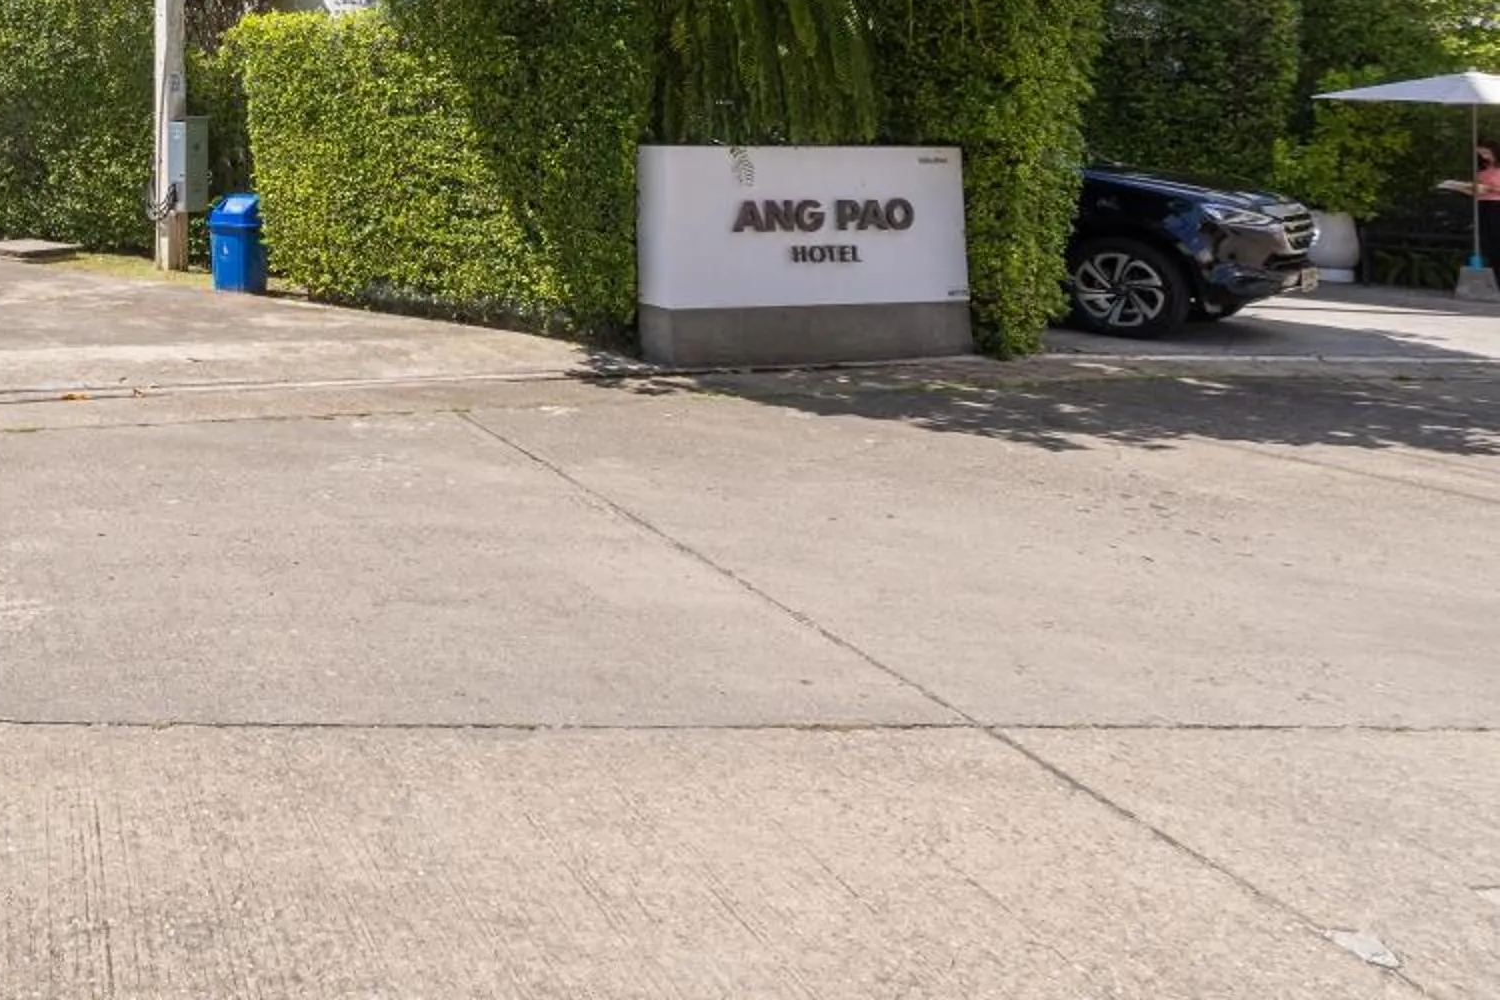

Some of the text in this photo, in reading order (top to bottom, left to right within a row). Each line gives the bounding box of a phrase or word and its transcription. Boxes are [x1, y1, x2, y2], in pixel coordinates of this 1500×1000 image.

[731, 196, 915, 233] ANG PAO
[790, 244, 862, 263] HOTEL
